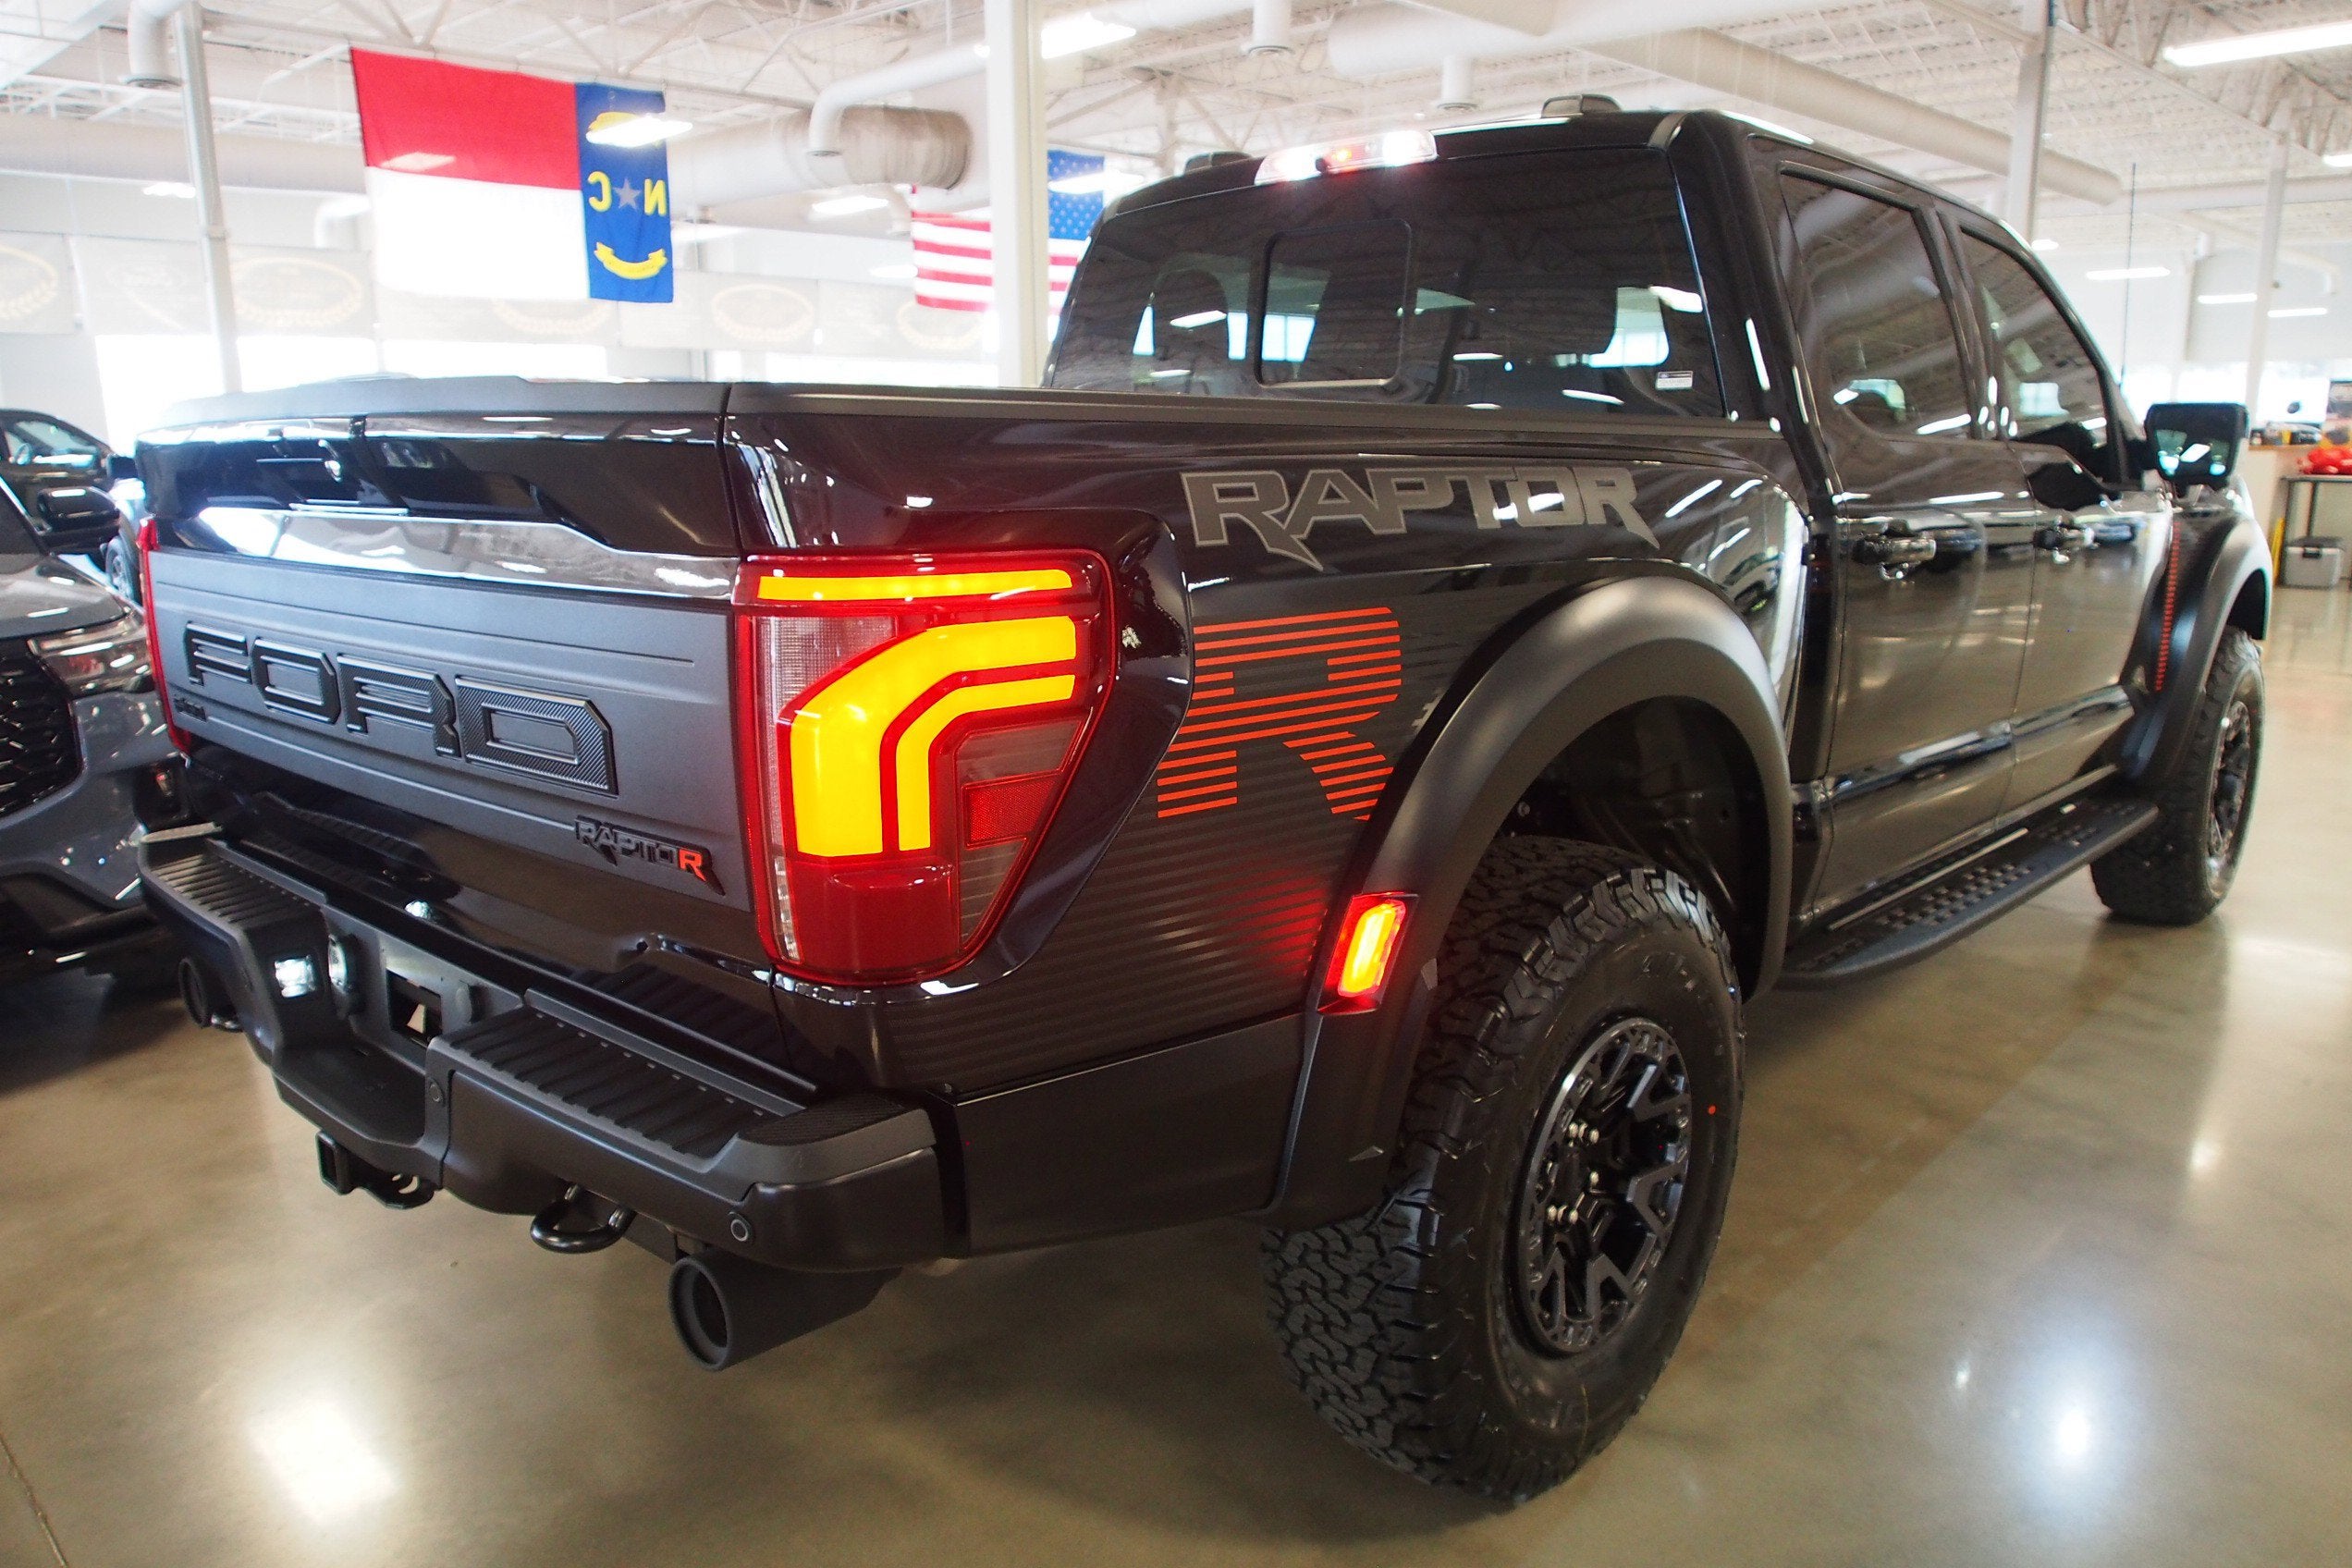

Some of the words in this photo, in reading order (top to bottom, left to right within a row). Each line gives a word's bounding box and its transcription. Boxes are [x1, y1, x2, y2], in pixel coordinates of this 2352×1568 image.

[1181, 466, 1660, 571] RAPTOR
[185, 620, 619, 797] FORD
[574, 815, 726, 896] RAPTOR
